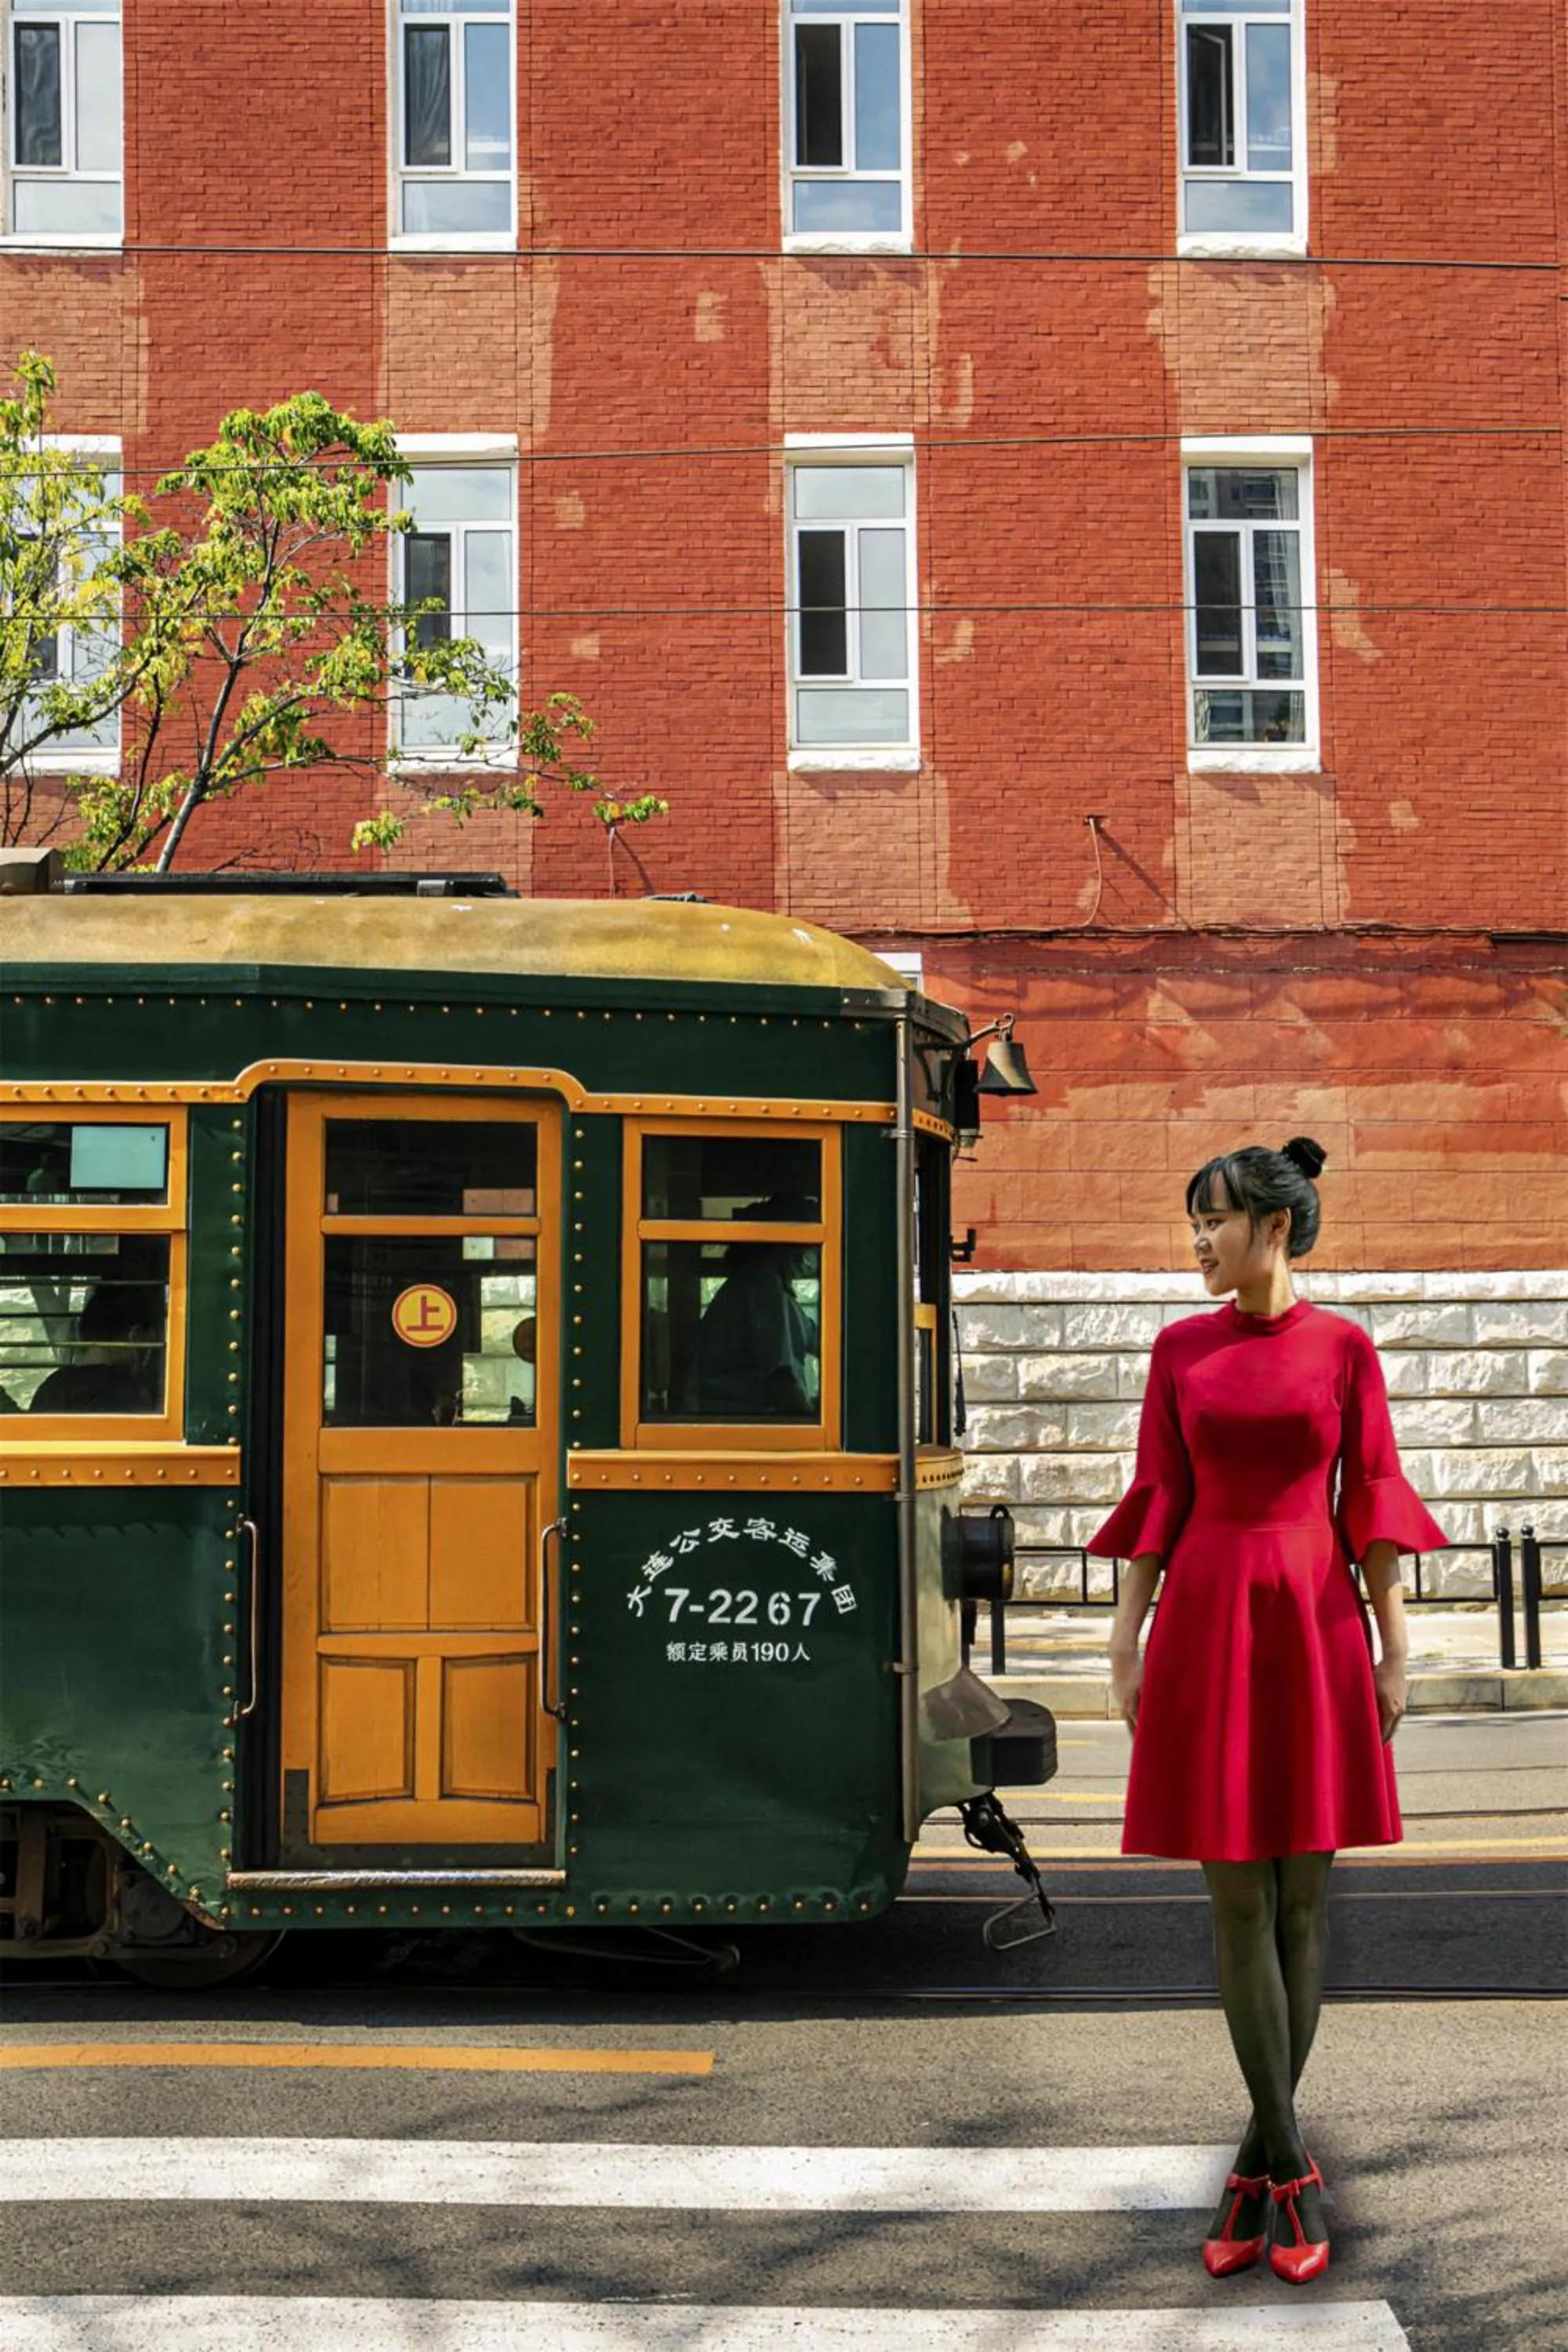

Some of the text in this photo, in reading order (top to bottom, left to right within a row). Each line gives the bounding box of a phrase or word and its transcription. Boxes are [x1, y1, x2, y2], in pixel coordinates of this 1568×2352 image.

[406, 1295, 444, 1331] 上
[626, 1517, 857, 1617] 大连公交客运集团
[664, 1588, 821, 1626] 7-2267
[666, 1641, 811, 1662] 额定乘员190人
